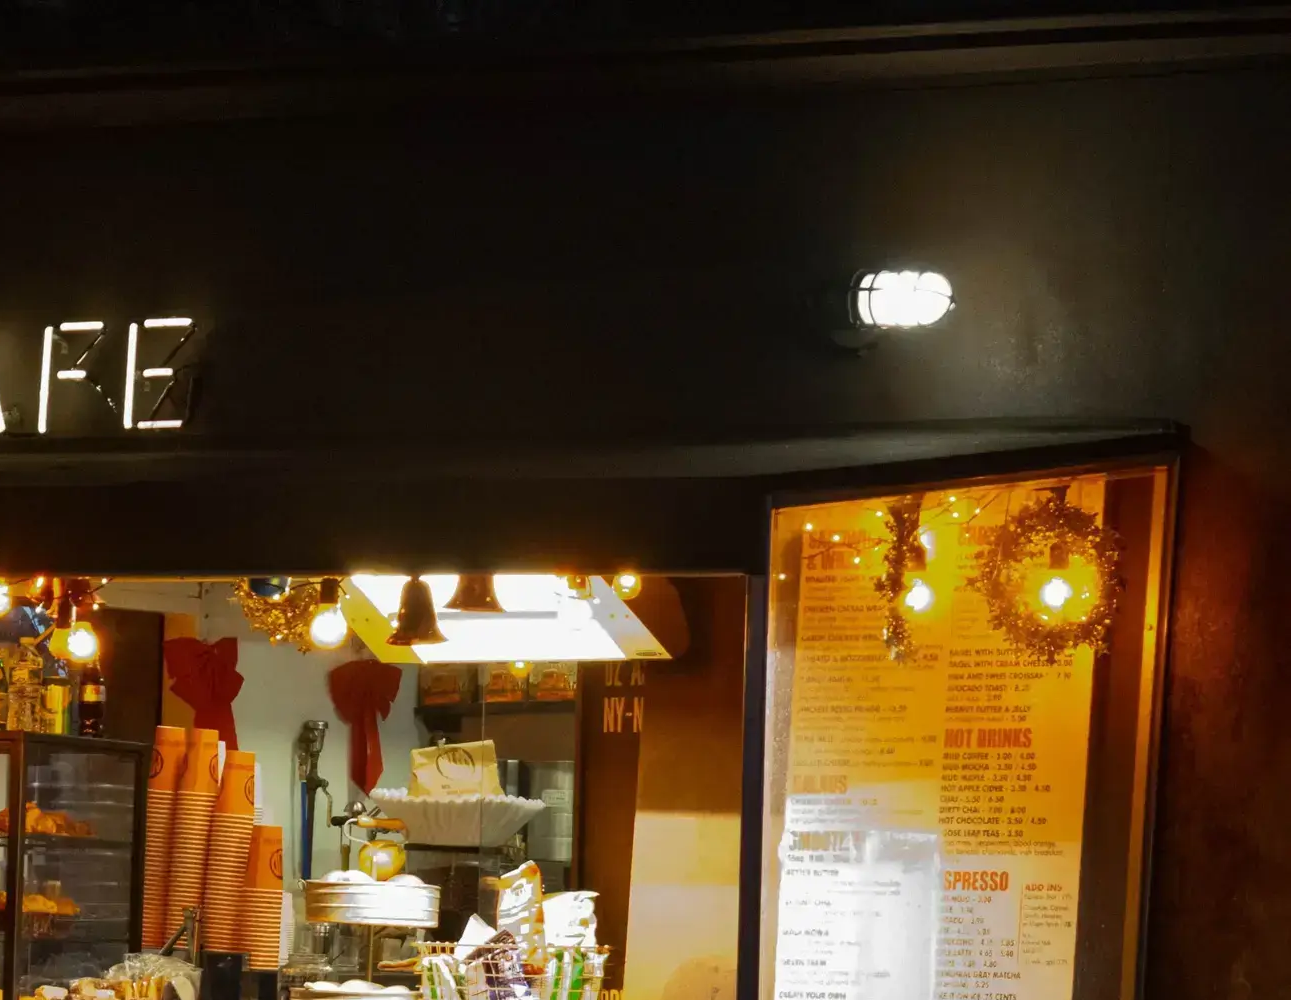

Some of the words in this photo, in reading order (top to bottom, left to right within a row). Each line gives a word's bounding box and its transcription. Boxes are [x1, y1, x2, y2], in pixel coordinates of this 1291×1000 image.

[974, 648, 994, 657] WITH
[974, 659, 994, 668] WITH
[1011, 705, 1032, 714] JELLY
[943, 728, 973, 749] HOT
[976, 727, 1033, 749] DRINKS
[962, 752, 989, 761] COFFEE
[961, 763, 990, 771] MOCHA
[958, 784, 980, 793] APPLE
[938, 817, 954, 825] HOT
[955, 816, 1000, 825] CHOCOLATE
[1030, 817, 1047, 825] 4.50
[963, 829, 981, 838] LEAF
[982, 829, 1001, 838] TEAS
[943, 870, 1010, 892] SPRESSO
[1025, 883, 1044, 892] ADD
[1046, 883, 1063, 892] INS
[992, 971, 1021, 980] MATCHA
[806, 992, 826, 1000] YOUR
